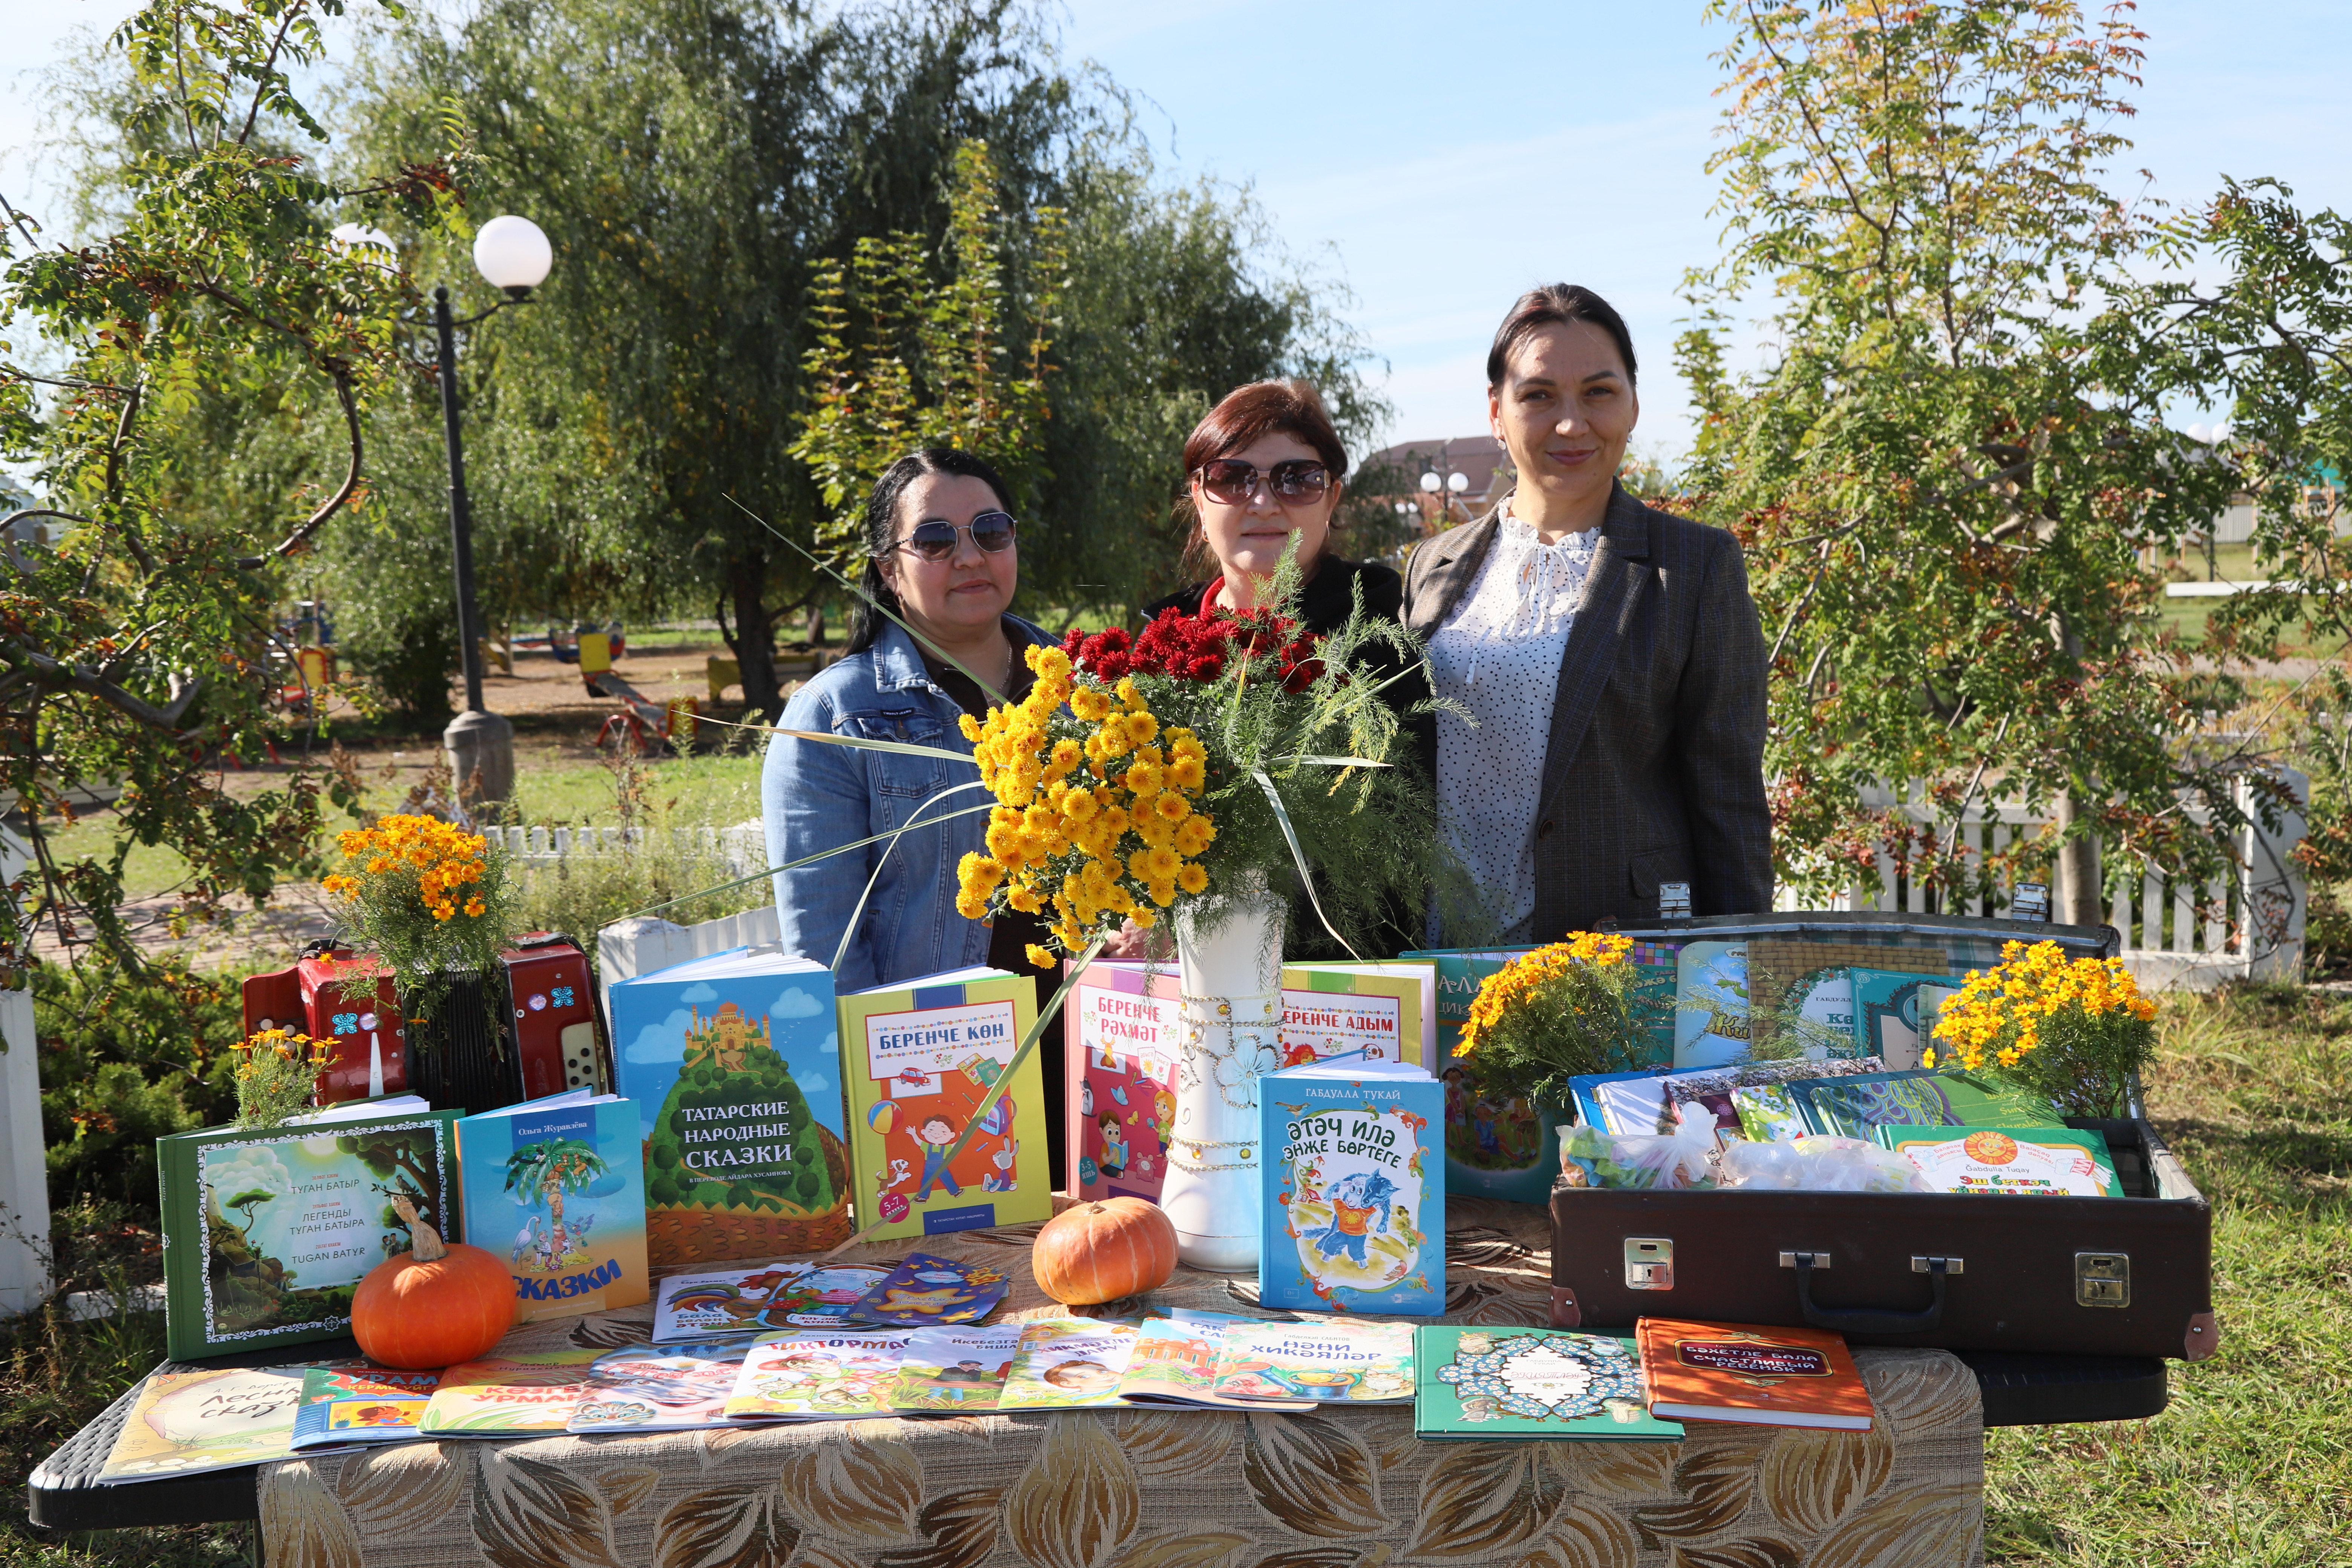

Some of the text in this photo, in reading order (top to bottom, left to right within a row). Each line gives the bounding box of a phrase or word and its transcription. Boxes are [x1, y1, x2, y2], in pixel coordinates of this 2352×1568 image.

[1098, 997, 1160, 1022] БЕРЕНЧЕ
[1283, 1011, 1393, 1032] ЕРЕНЧЕ АДЫМ
[880, 1023, 1004, 1050] БЕРЕНЧЕ КӨН
[1101, 1020, 1158, 1043] РӘХМӘТ
[1306, 1088, 1401, 1100] ГАБДУЛЛА ТУКАЙ
[682, 1101, 790, 1122] ТАТАРСКИЕ
[518, 1121, 587, 1136] Ольга Журавлёва
[684, 1122, 791, 1144] НАРОДНЫЕ
[1934, 1144, 1962, 1153] Балачак
[2020, 1144, 2050, 1158] Balaçaq
[686, 1144, 792, 1169] СКАЗКИ
[1081, 1161, 1091, 1171] 3-5
[727, 1172, 752, 1180] АЙДАРА
[1960, 1174, 2051, 1186] Эш беткәч
[291, 1179, 359, 1194] ТУГАН БАТЫР
[884, 1196, 899, 1211] 5-7
[302, 1208, 351, 1222] ЛЕГЕНДЫ
[289, 1219, 365, 1235] ТУГАН БАТЫРА
[291, 1247, 365, 1264] TUGAN BATYR
[1036, 1338, 1136, 1353] ХИКМӘТЛЕ
[1075, 1345, 1117, 1356] ДАРУ
[1250, 1345, 1381, 1360] ХИКӘЯЛӘР
[1283, 1341, 1350, 1351] НӘНИ
[1686, 1347, 1818, 1361] БӘХЕТЛЕ БАЛА
[1694, 1355, 1815, 1369] СЧАСТЛИВЫЙ
[347, 1374, 438, 1385] УРАМ
